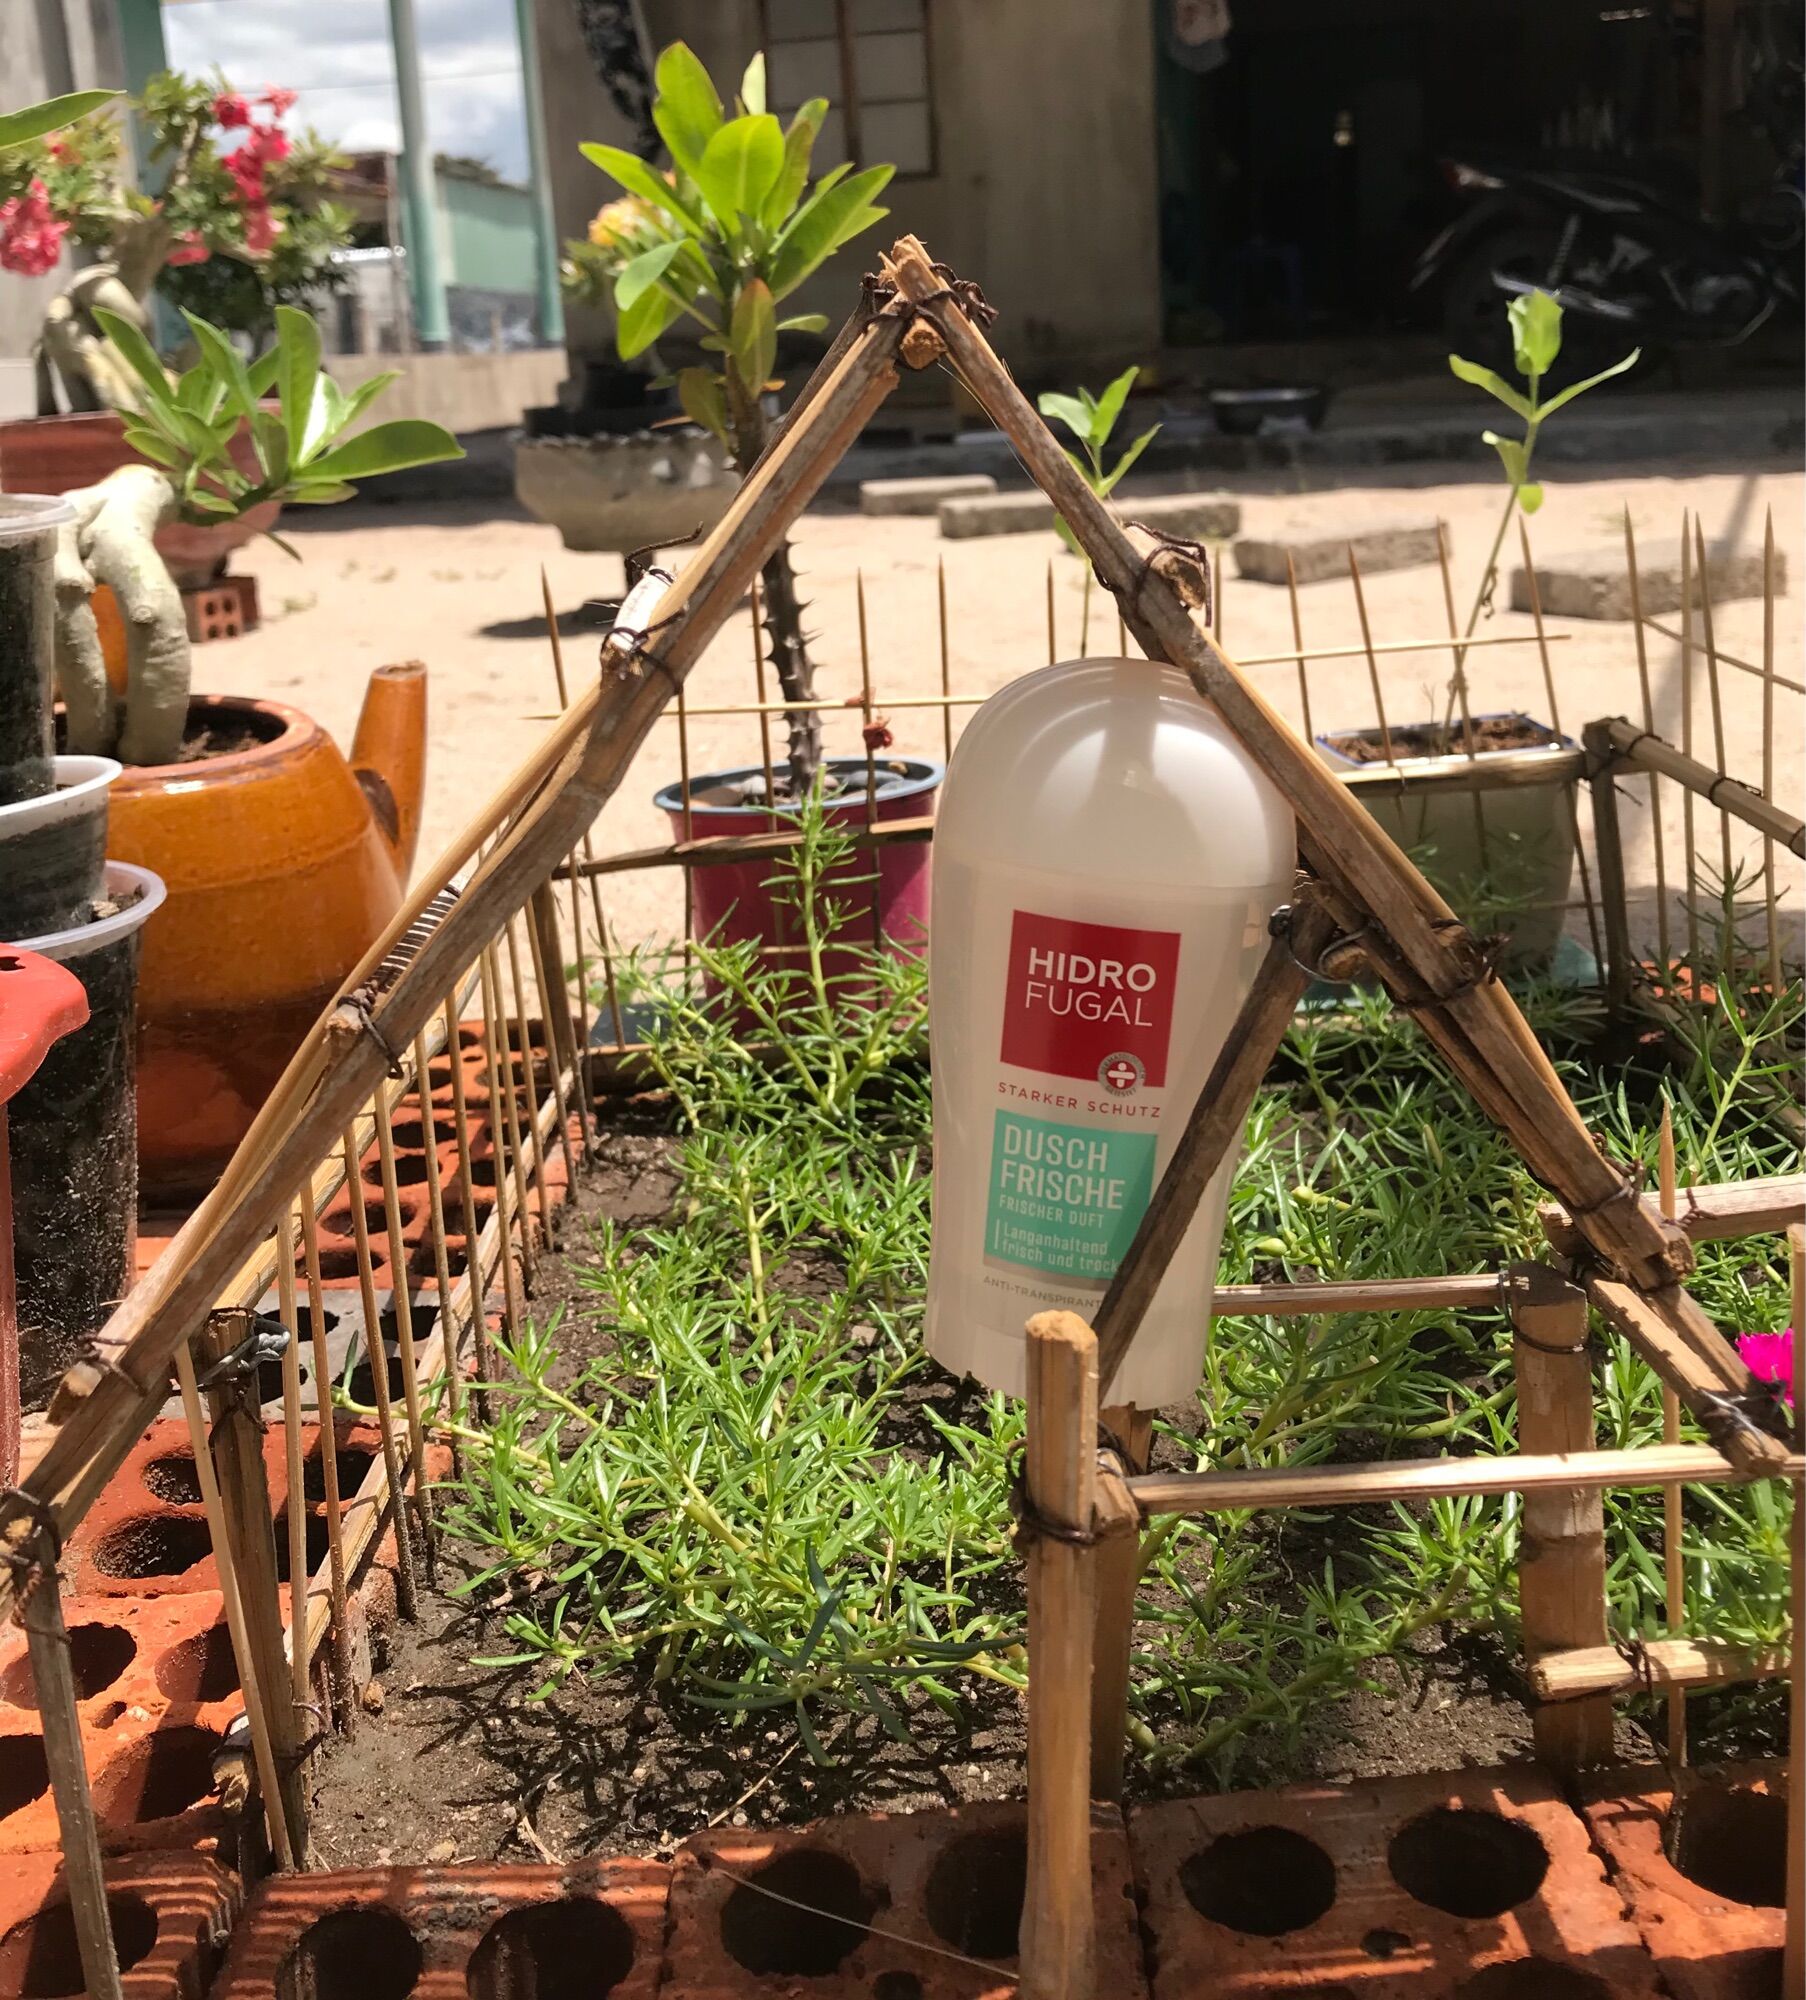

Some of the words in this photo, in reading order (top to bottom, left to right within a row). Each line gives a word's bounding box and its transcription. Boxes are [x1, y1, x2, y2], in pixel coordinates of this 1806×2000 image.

[1028, 947, 1157, 993] HIDRO
[1025, 981, 1153, 1027] FUGAL
[998, 1082, 1078, 1110] STARKER
[1087, 1100, 1161, 1118] SCHUTZ
[1003, 1123, 1109, 1172] DUSCH
[1000, 1159, 1126, 1210] FRISCHE
[999, 1194, 1064, 1223] FRISCHER
[1069, 1210, 1105, 1229] DUFT
[1002, 1239, 1043, 1262] frisch
[1048, 1253, 1075, 1268] und
[1004, 1221, 1109, 1255] Langanhaltend
